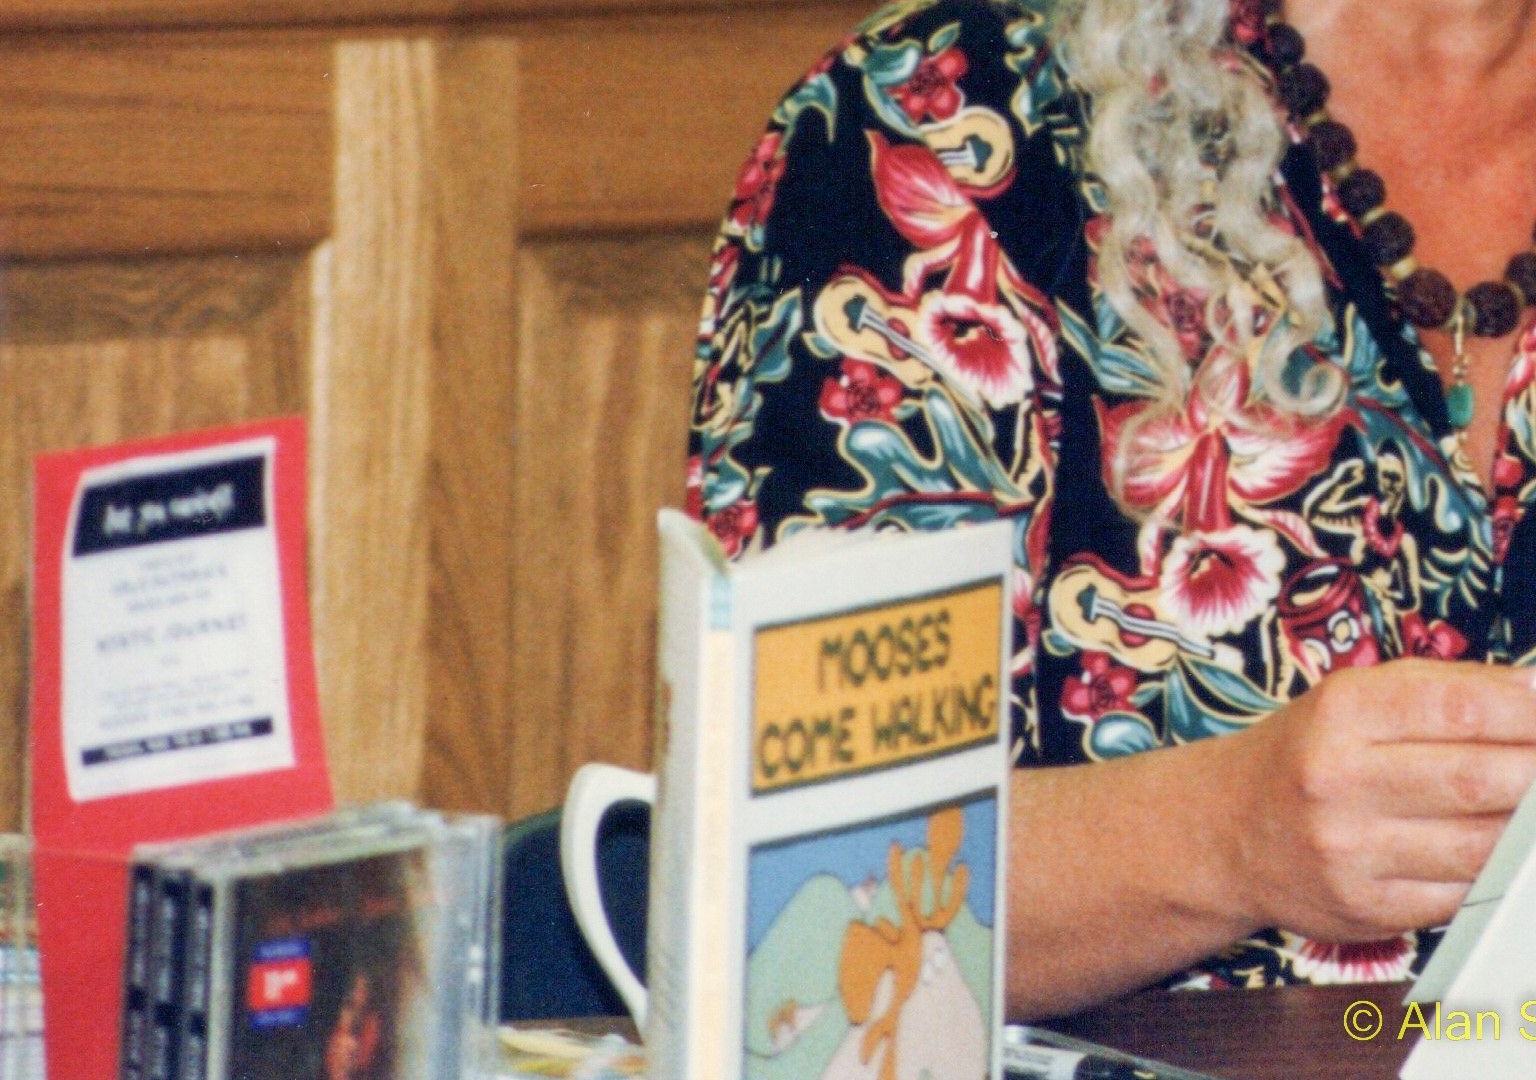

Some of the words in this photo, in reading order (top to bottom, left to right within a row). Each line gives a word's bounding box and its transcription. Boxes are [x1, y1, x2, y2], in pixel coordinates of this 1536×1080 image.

[818, 609, 951, 691] MOOSES
[759, 706, 855, 779] COME
[871, 674, 995, 754] WALKING
